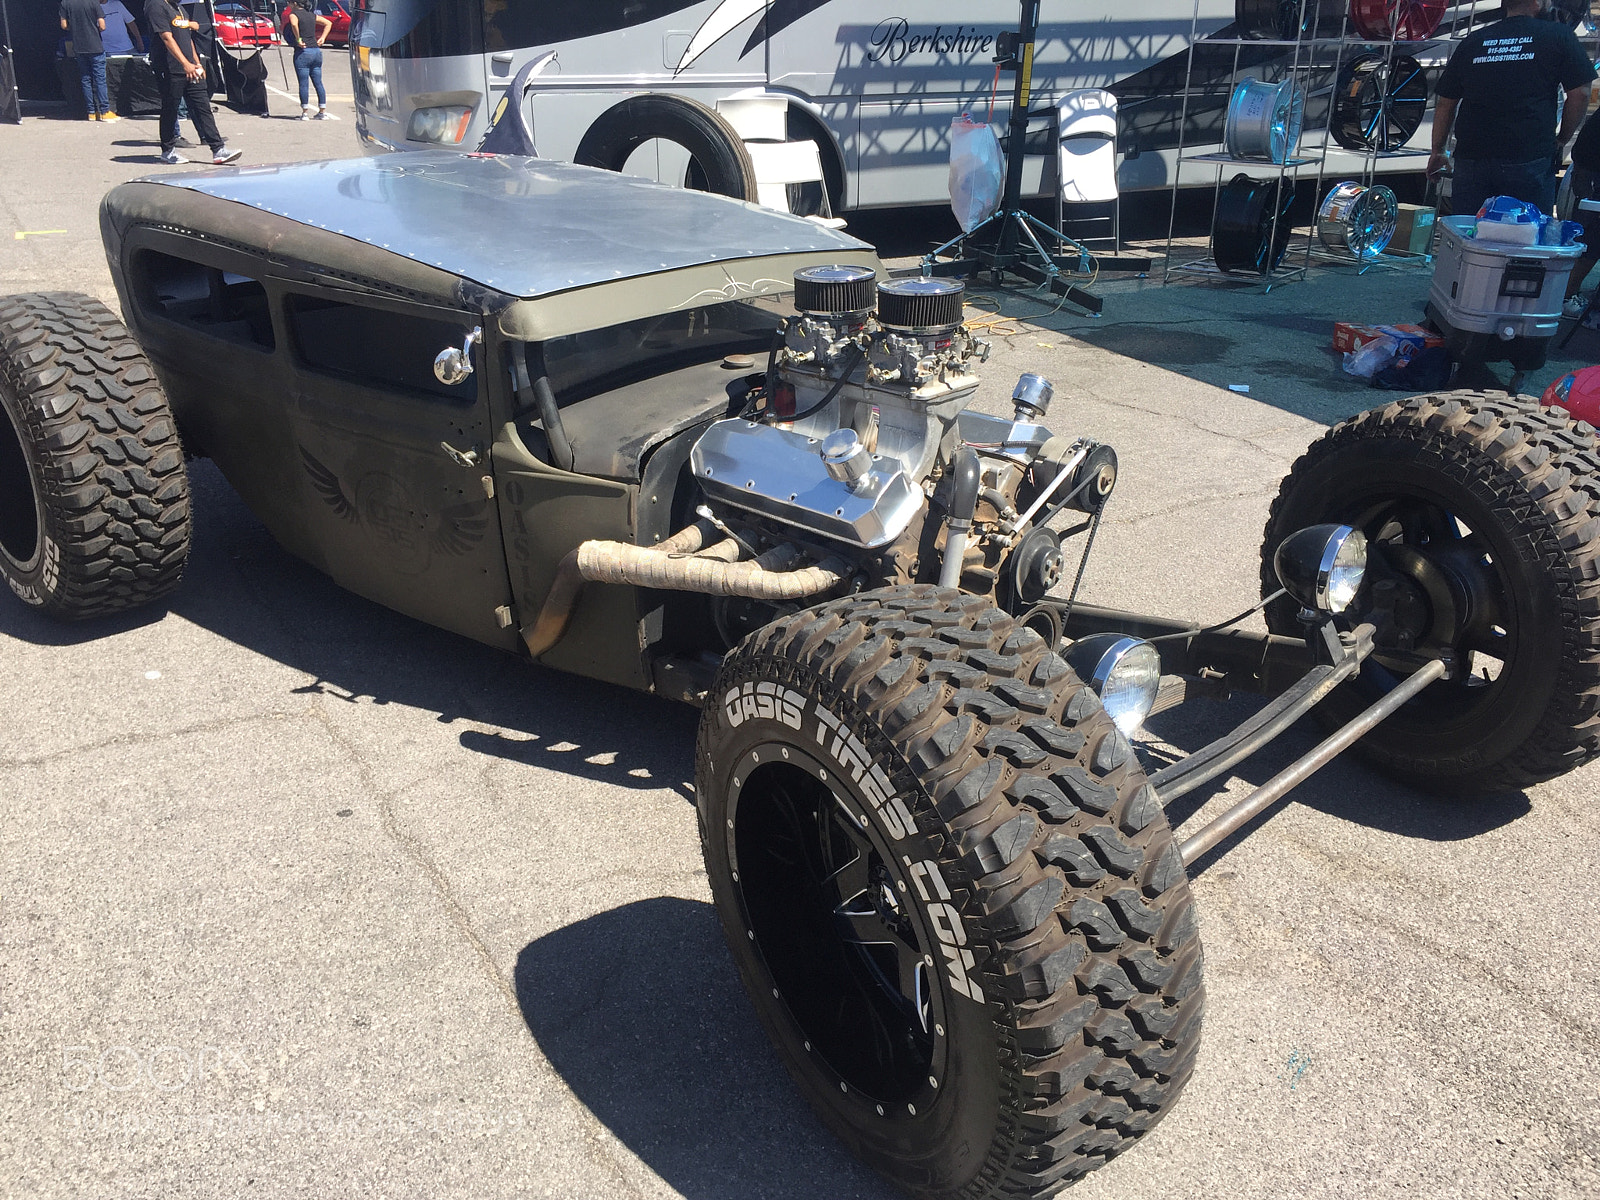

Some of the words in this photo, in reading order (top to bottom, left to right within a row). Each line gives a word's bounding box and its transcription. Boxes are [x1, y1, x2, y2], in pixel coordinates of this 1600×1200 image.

[867, 16, 993, 61] Berkshire
[1519, 36, 1534, 44] CALL
[1472, 52, 1535, 64] WWW.OASISTIRES.COM
[725, 681, 808, 731] OASIS
[814, 702, 920, 841] TIRES
